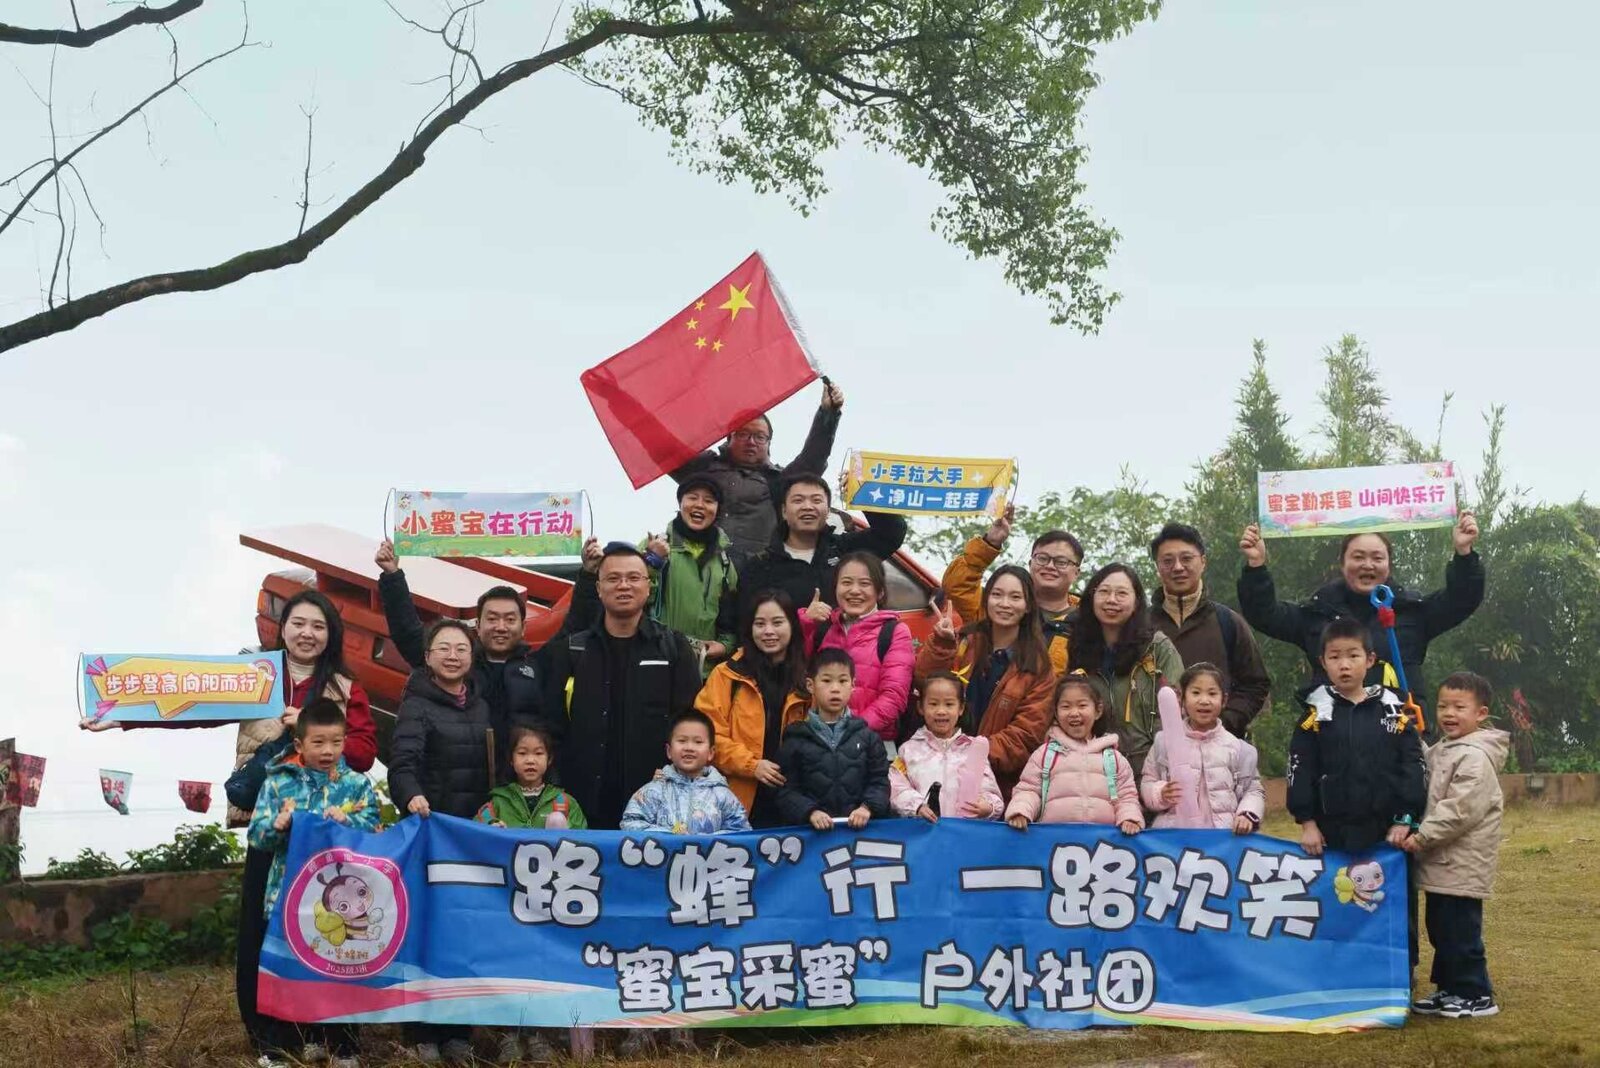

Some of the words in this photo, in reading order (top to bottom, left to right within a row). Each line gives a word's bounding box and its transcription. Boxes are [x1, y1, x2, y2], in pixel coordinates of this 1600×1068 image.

[870, 463, 963, 485] 小手拉大手
[888, 488, 980, 509] 净山一起走
[1267, 489, 1353, 513] 蜜宝勤采蜜
[1358, 485, 1446, 507] 山间快乐行
[401, 509, 574, 537] 小蜜宝在行动
